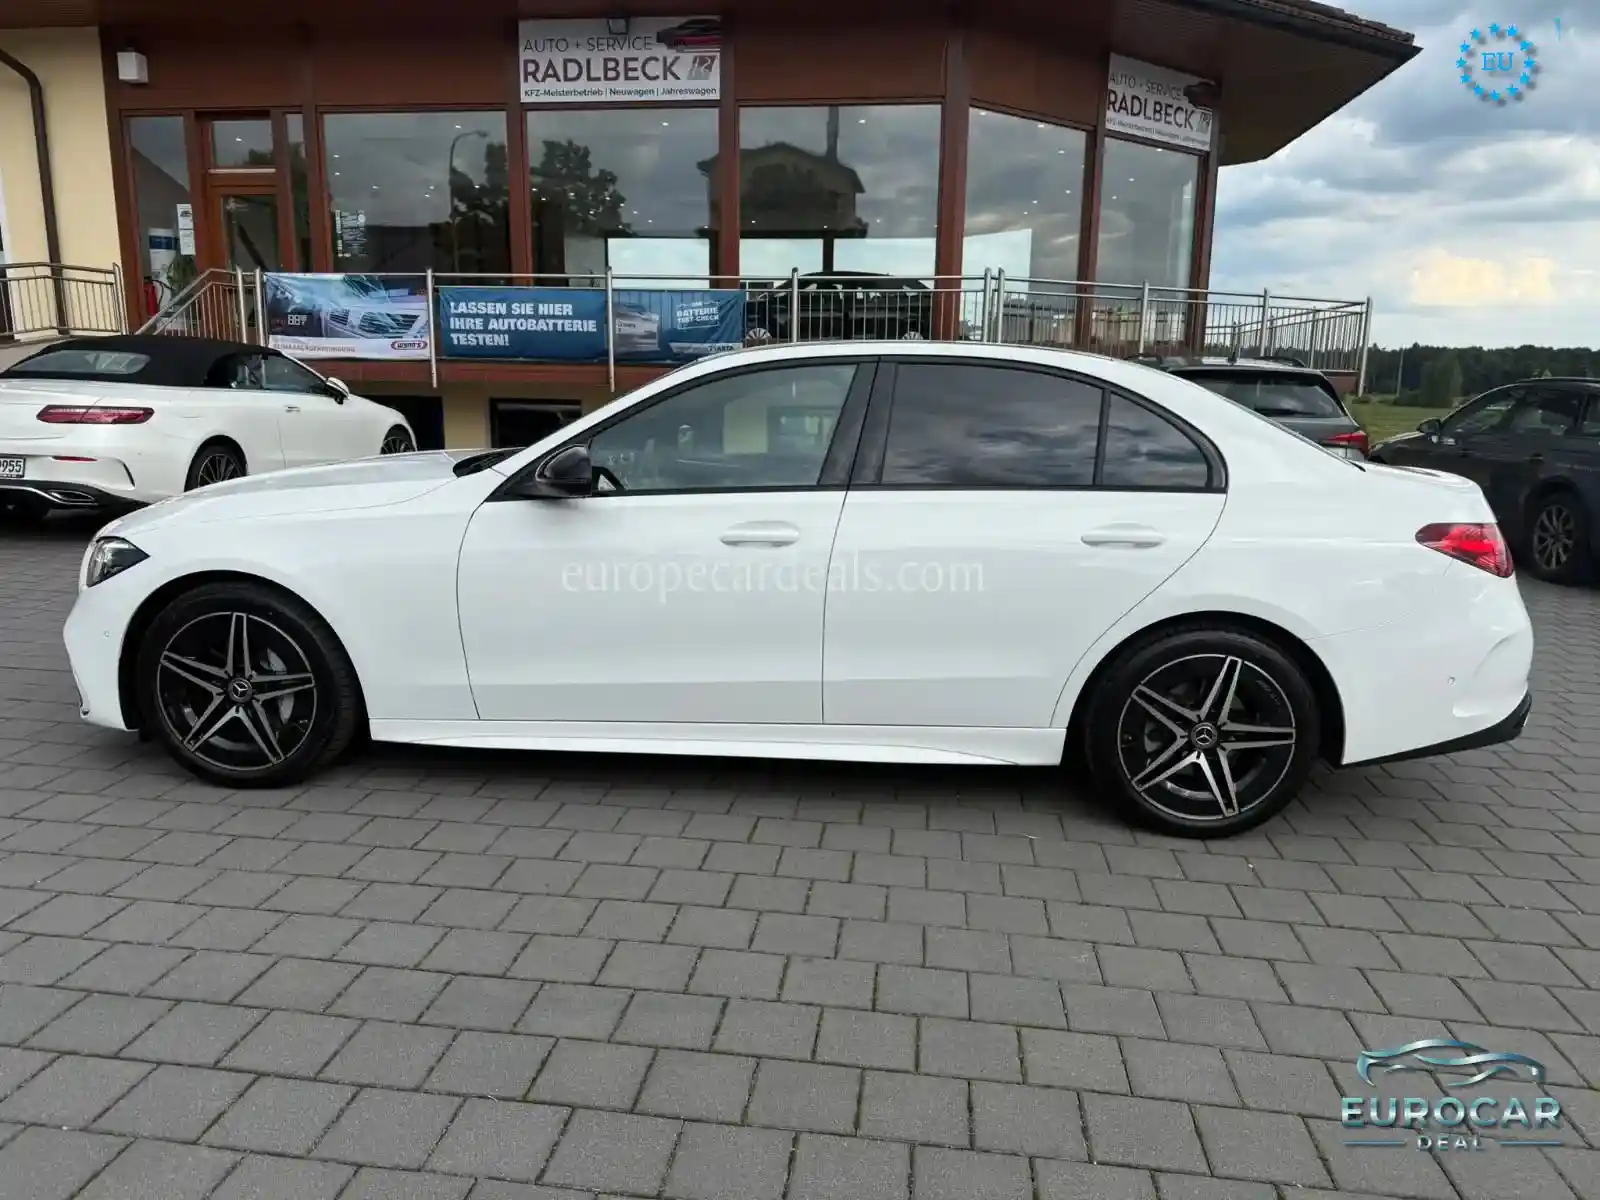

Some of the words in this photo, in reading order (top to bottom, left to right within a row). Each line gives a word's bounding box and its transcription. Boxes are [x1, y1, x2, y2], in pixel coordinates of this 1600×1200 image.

[523, 38, 569, 53] AUTO
[586, 36, 653, 52] SERVICE
[523, 56, 681, 83] RADLBECK
[524, 88, 604, 97] KFZ-Meisterbetrieb
[609, 88, 655, 97] Neuwagen
[661, 87, 717, 97] Jahreswagen
[1110, 72, 1136, 89] AUTO
[1145, 80, 1182, 100] SERVICE
[1107, 89, 1195, 131] RADLBECK
[450, 302, 507, 315] LASSEN
[511, 303, 536, 315] SIE
[539, 304, 573, 316] HIER
[450, 318, 484, 330] IHRE
[488, 319, 597, 332] AUTOBATTERIE
[451, 333, 509, 346] TESTEN!
[0, 459, 22, 473] 955
